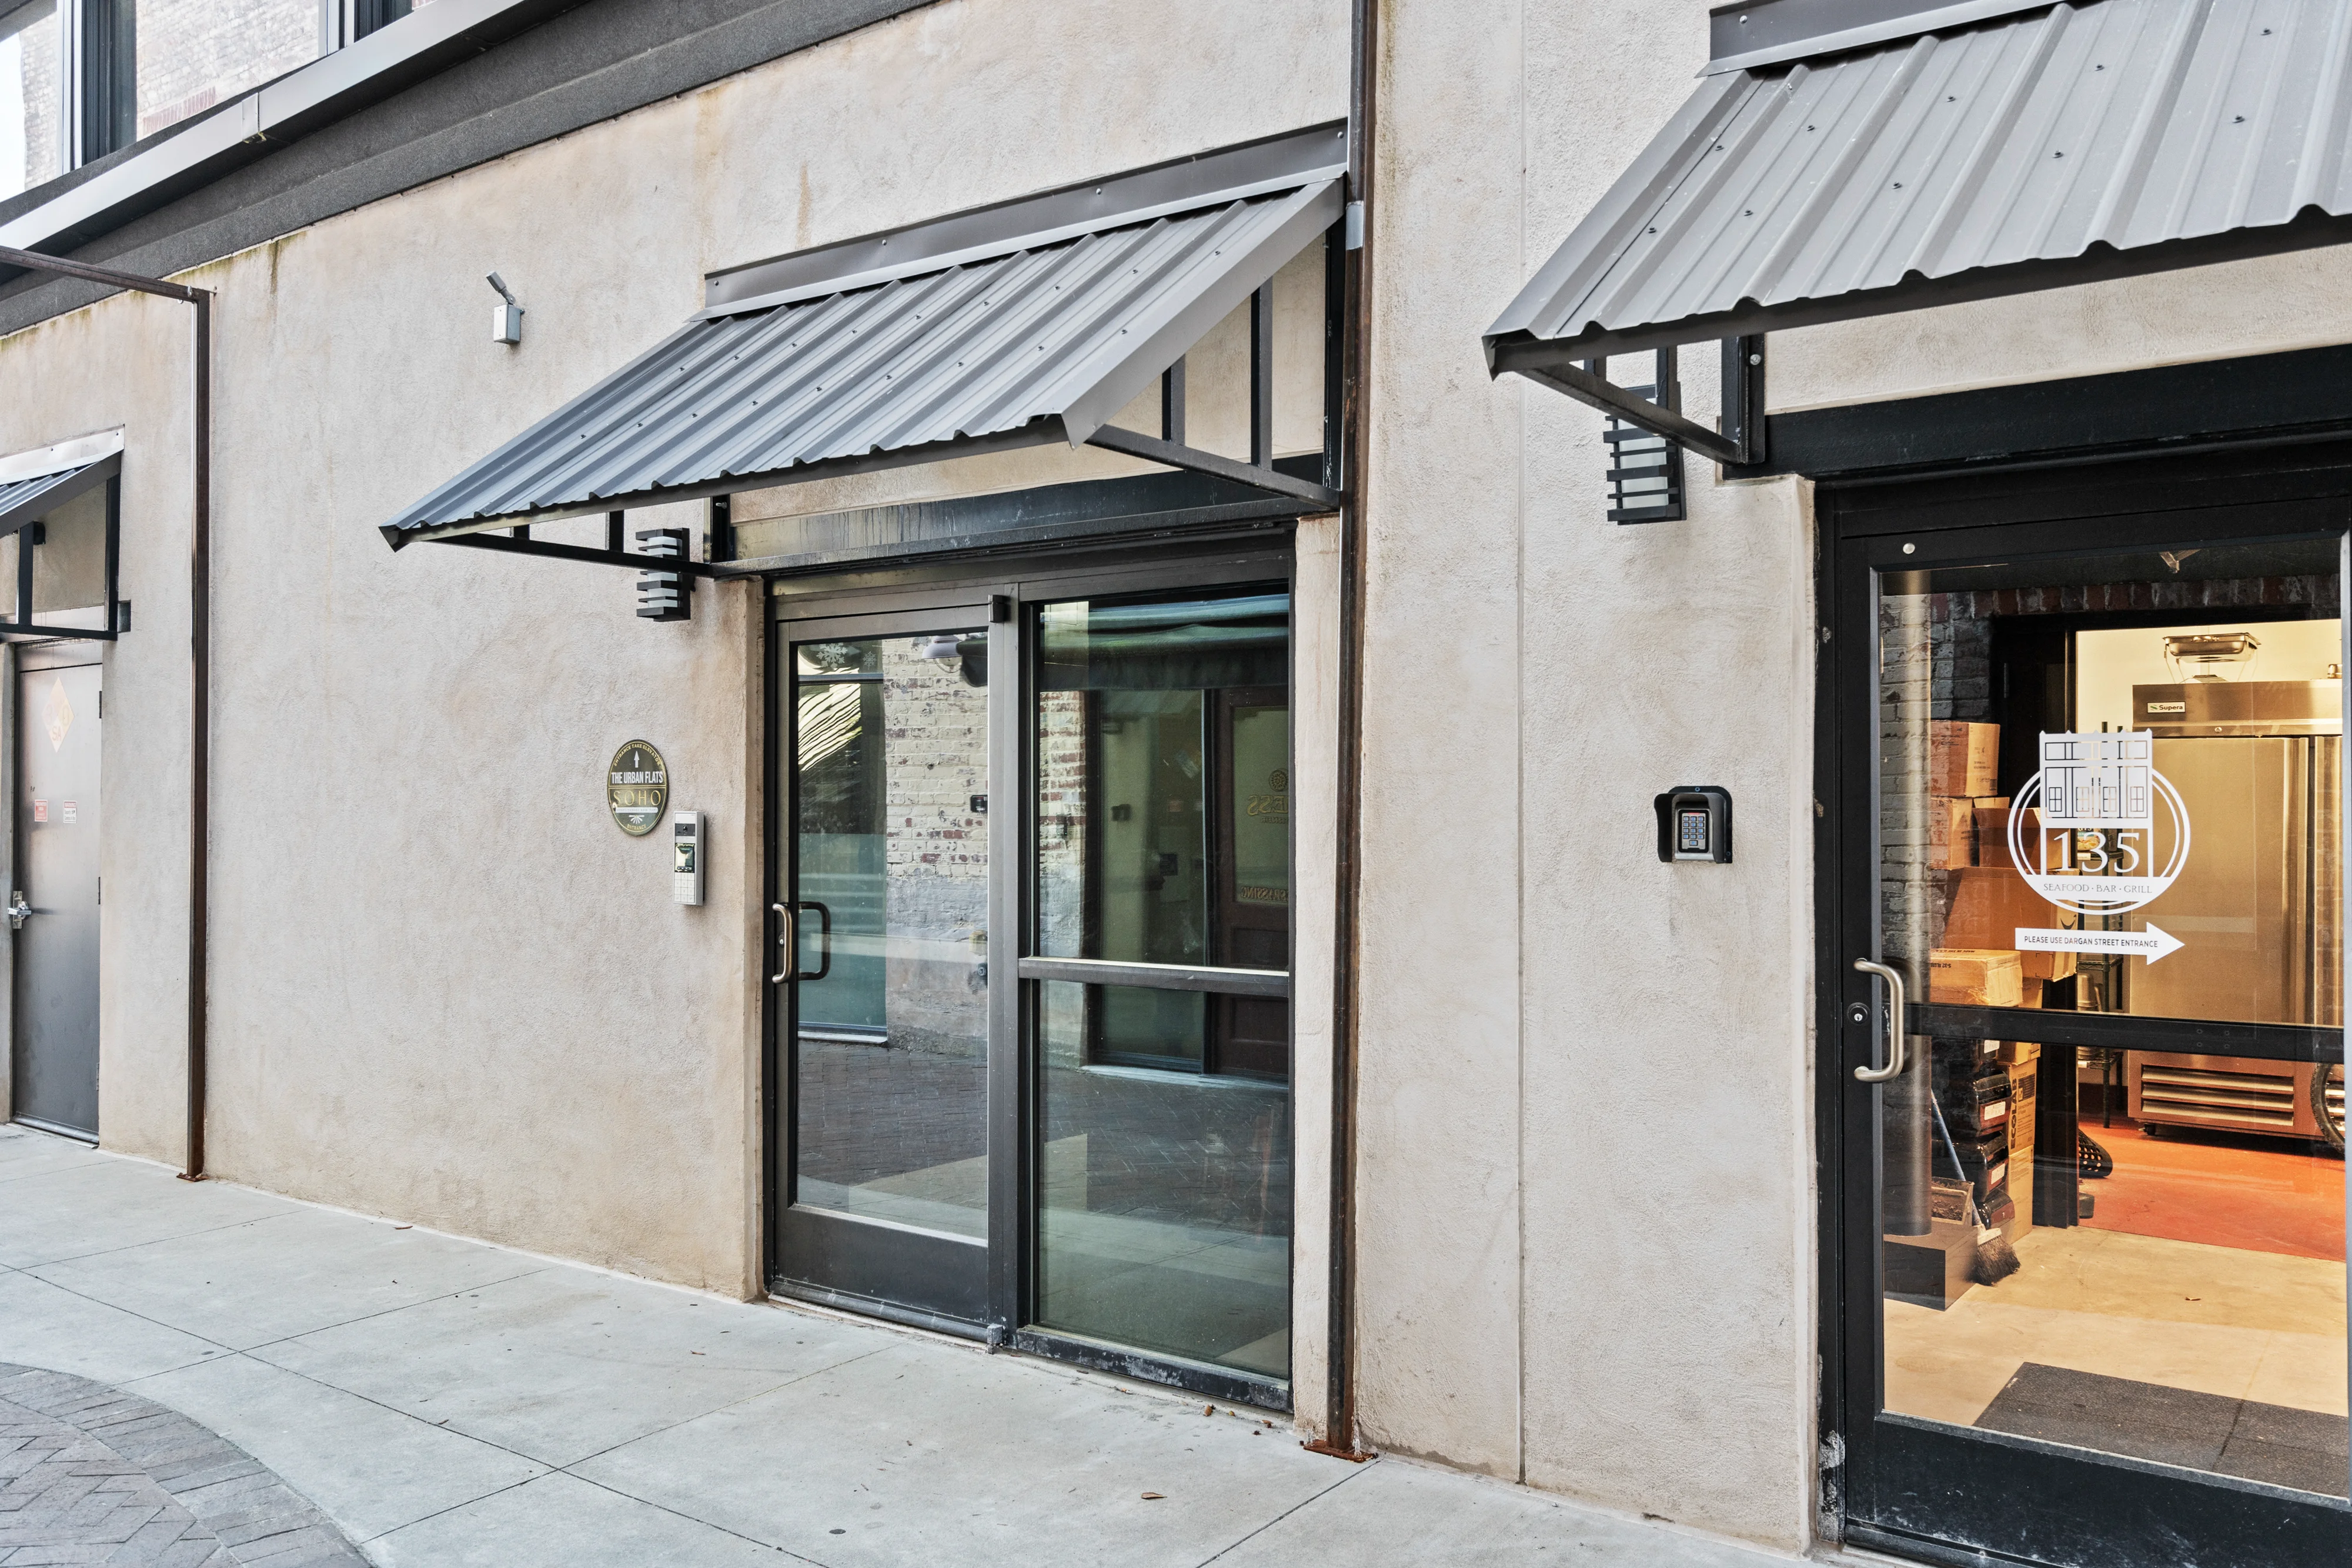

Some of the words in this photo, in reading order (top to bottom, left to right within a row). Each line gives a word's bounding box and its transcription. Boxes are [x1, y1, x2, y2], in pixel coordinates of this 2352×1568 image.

[52, 726, 62, 741] SA
[614, 744, 632, 767] ENTRANCE
[642, 745, 662, 766] ELEVATOR
[612, 772, 623, 784] THE
[623, 771, 644, 784] URBAN
[644, 771, 663, 783] FLATS
[613, 790, 662, 806] SOHO
[2053, 831, 2140, 872] 135
[2043, 884, 2089, 892] SEAFOOD
